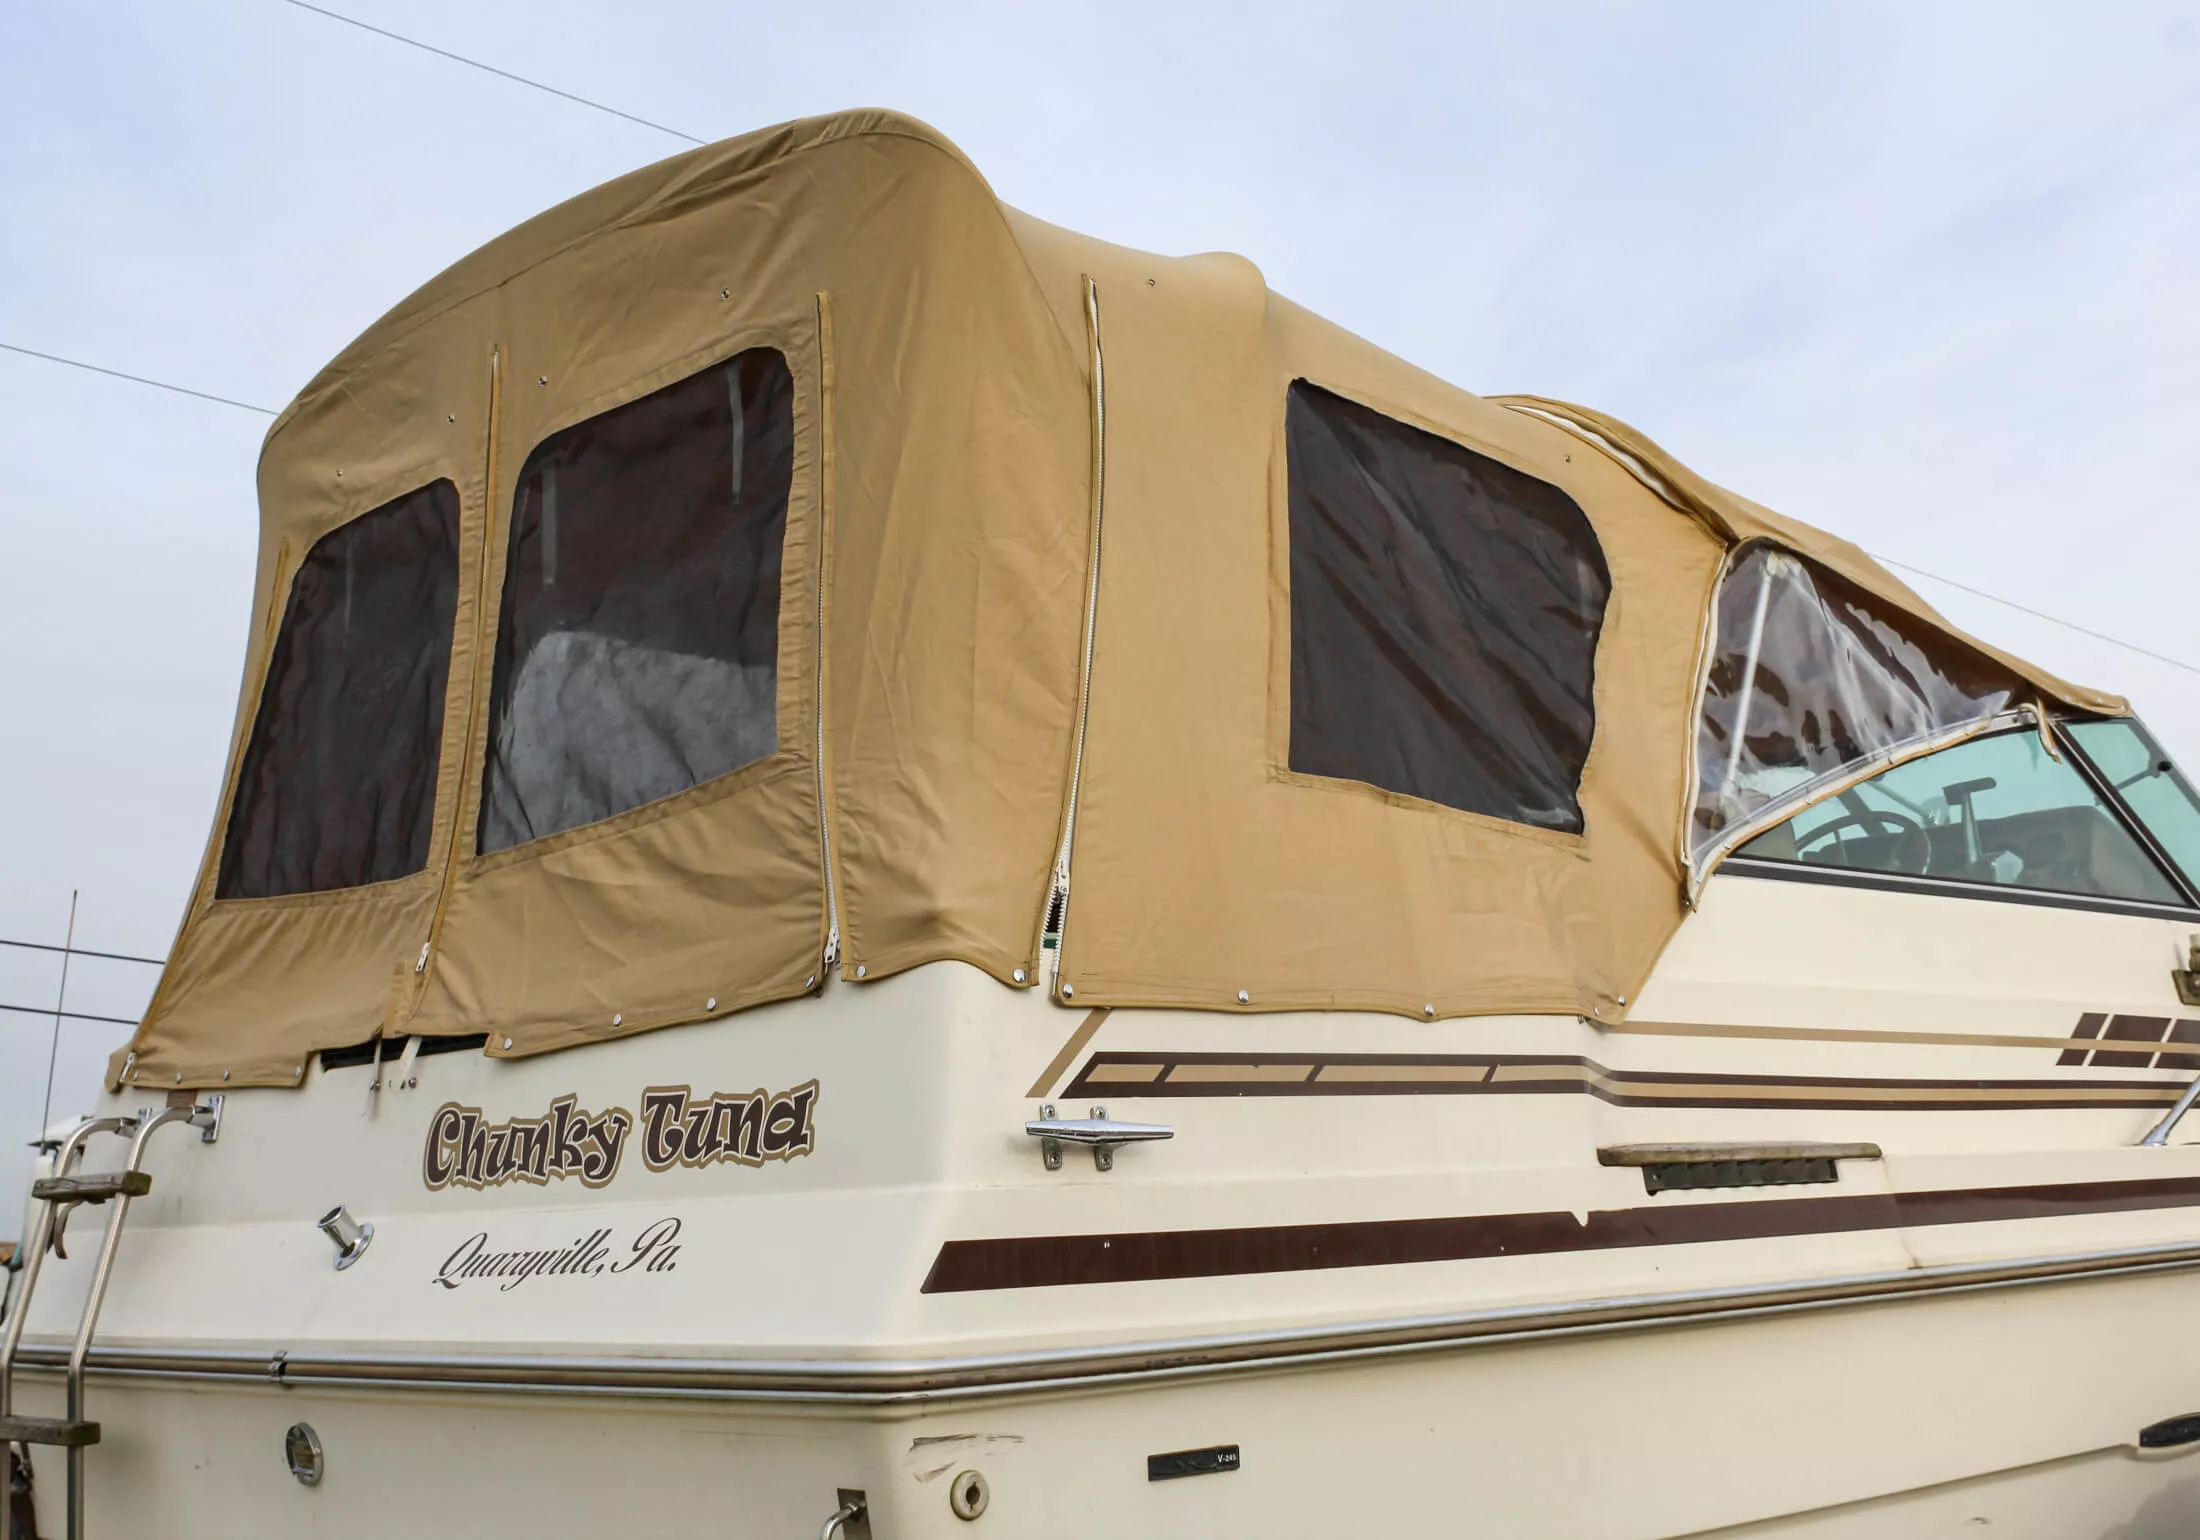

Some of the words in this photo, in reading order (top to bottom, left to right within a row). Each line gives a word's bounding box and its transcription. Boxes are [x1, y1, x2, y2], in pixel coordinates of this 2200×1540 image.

[423, 1092, 633, 1191] Chunky
[641, 1079, 820, 1173] Tuna
[432, 1228, 612, 1291] Quarryville,
[611, 1217, 682, 1273] Pa.
